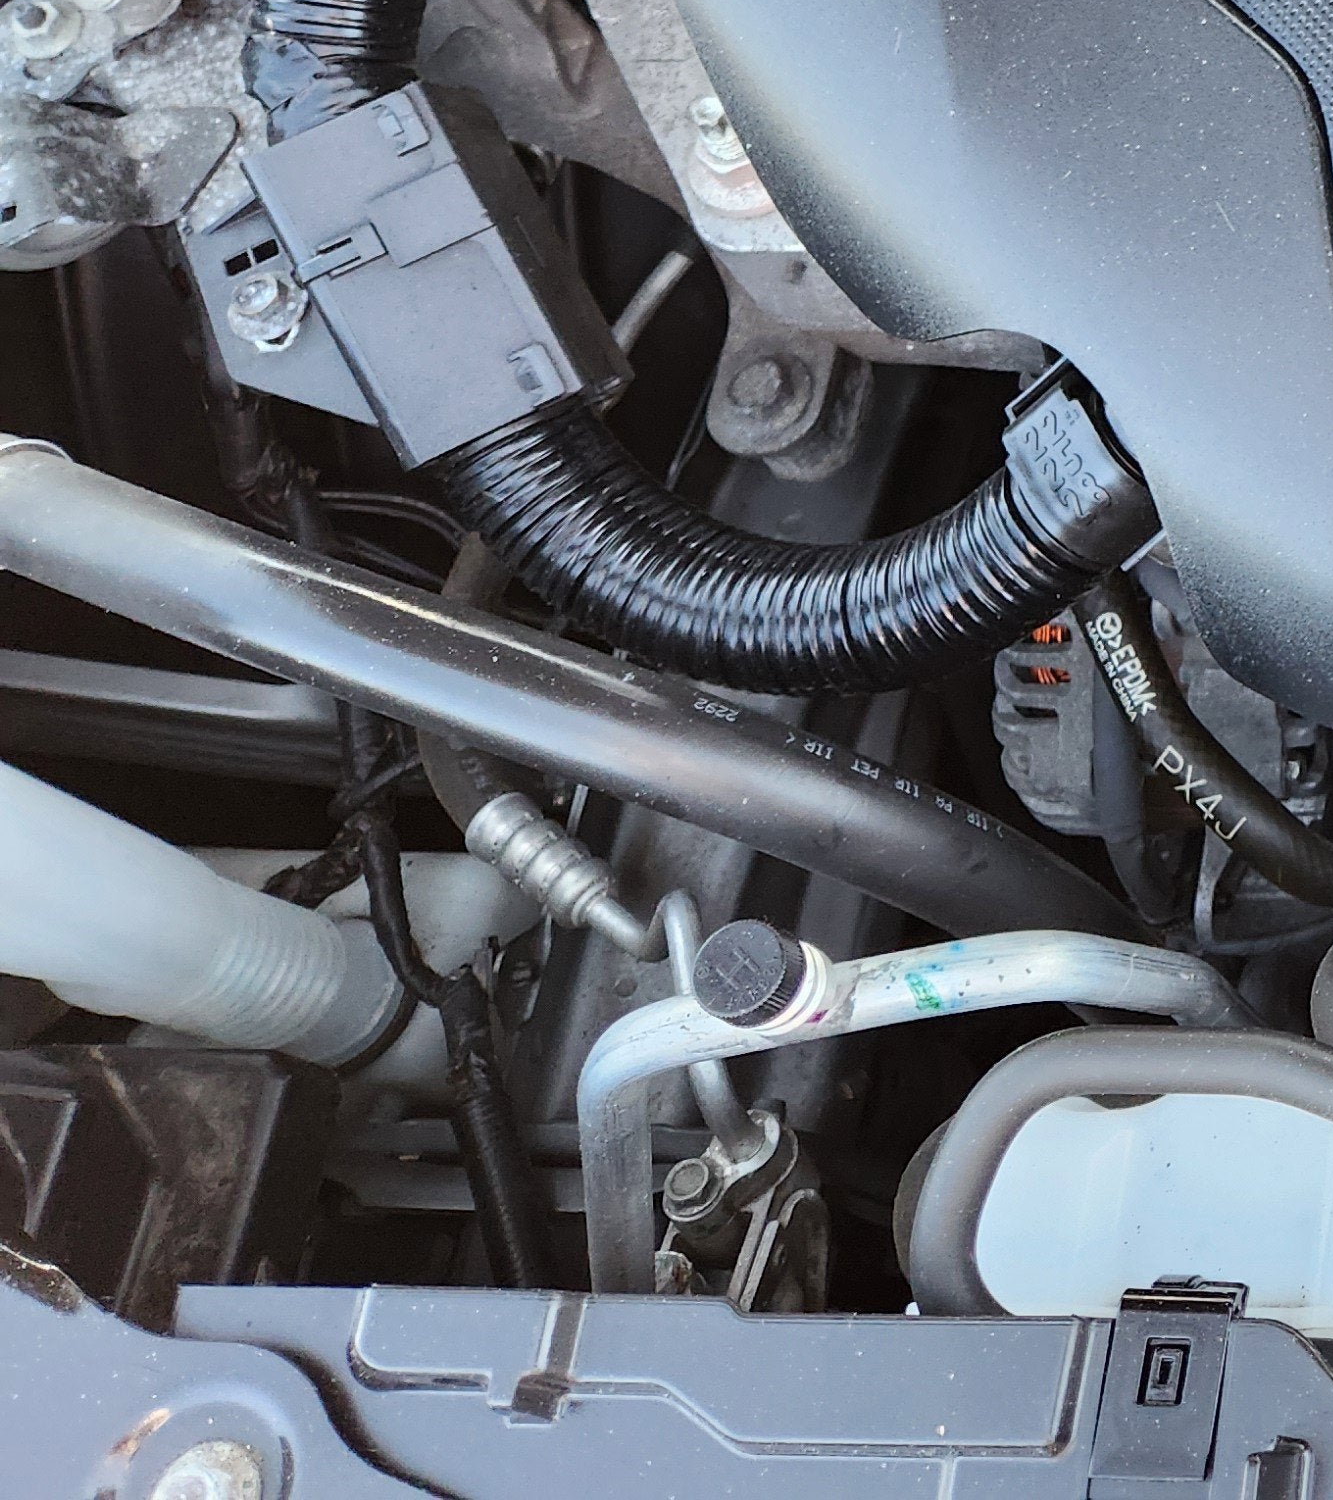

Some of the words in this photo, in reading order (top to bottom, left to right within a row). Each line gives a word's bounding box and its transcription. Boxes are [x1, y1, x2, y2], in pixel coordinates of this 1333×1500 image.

[1085, 621, 1108, 661] MADE
[1102, 660, 1117, 678] IN
[1111, 678, 1138, 721] CHINA
[1108, 631, 1159, 716] >EPDM<
[849, 756, 882, 780] PET
[1152, 744, 1247, 840] PX4J
